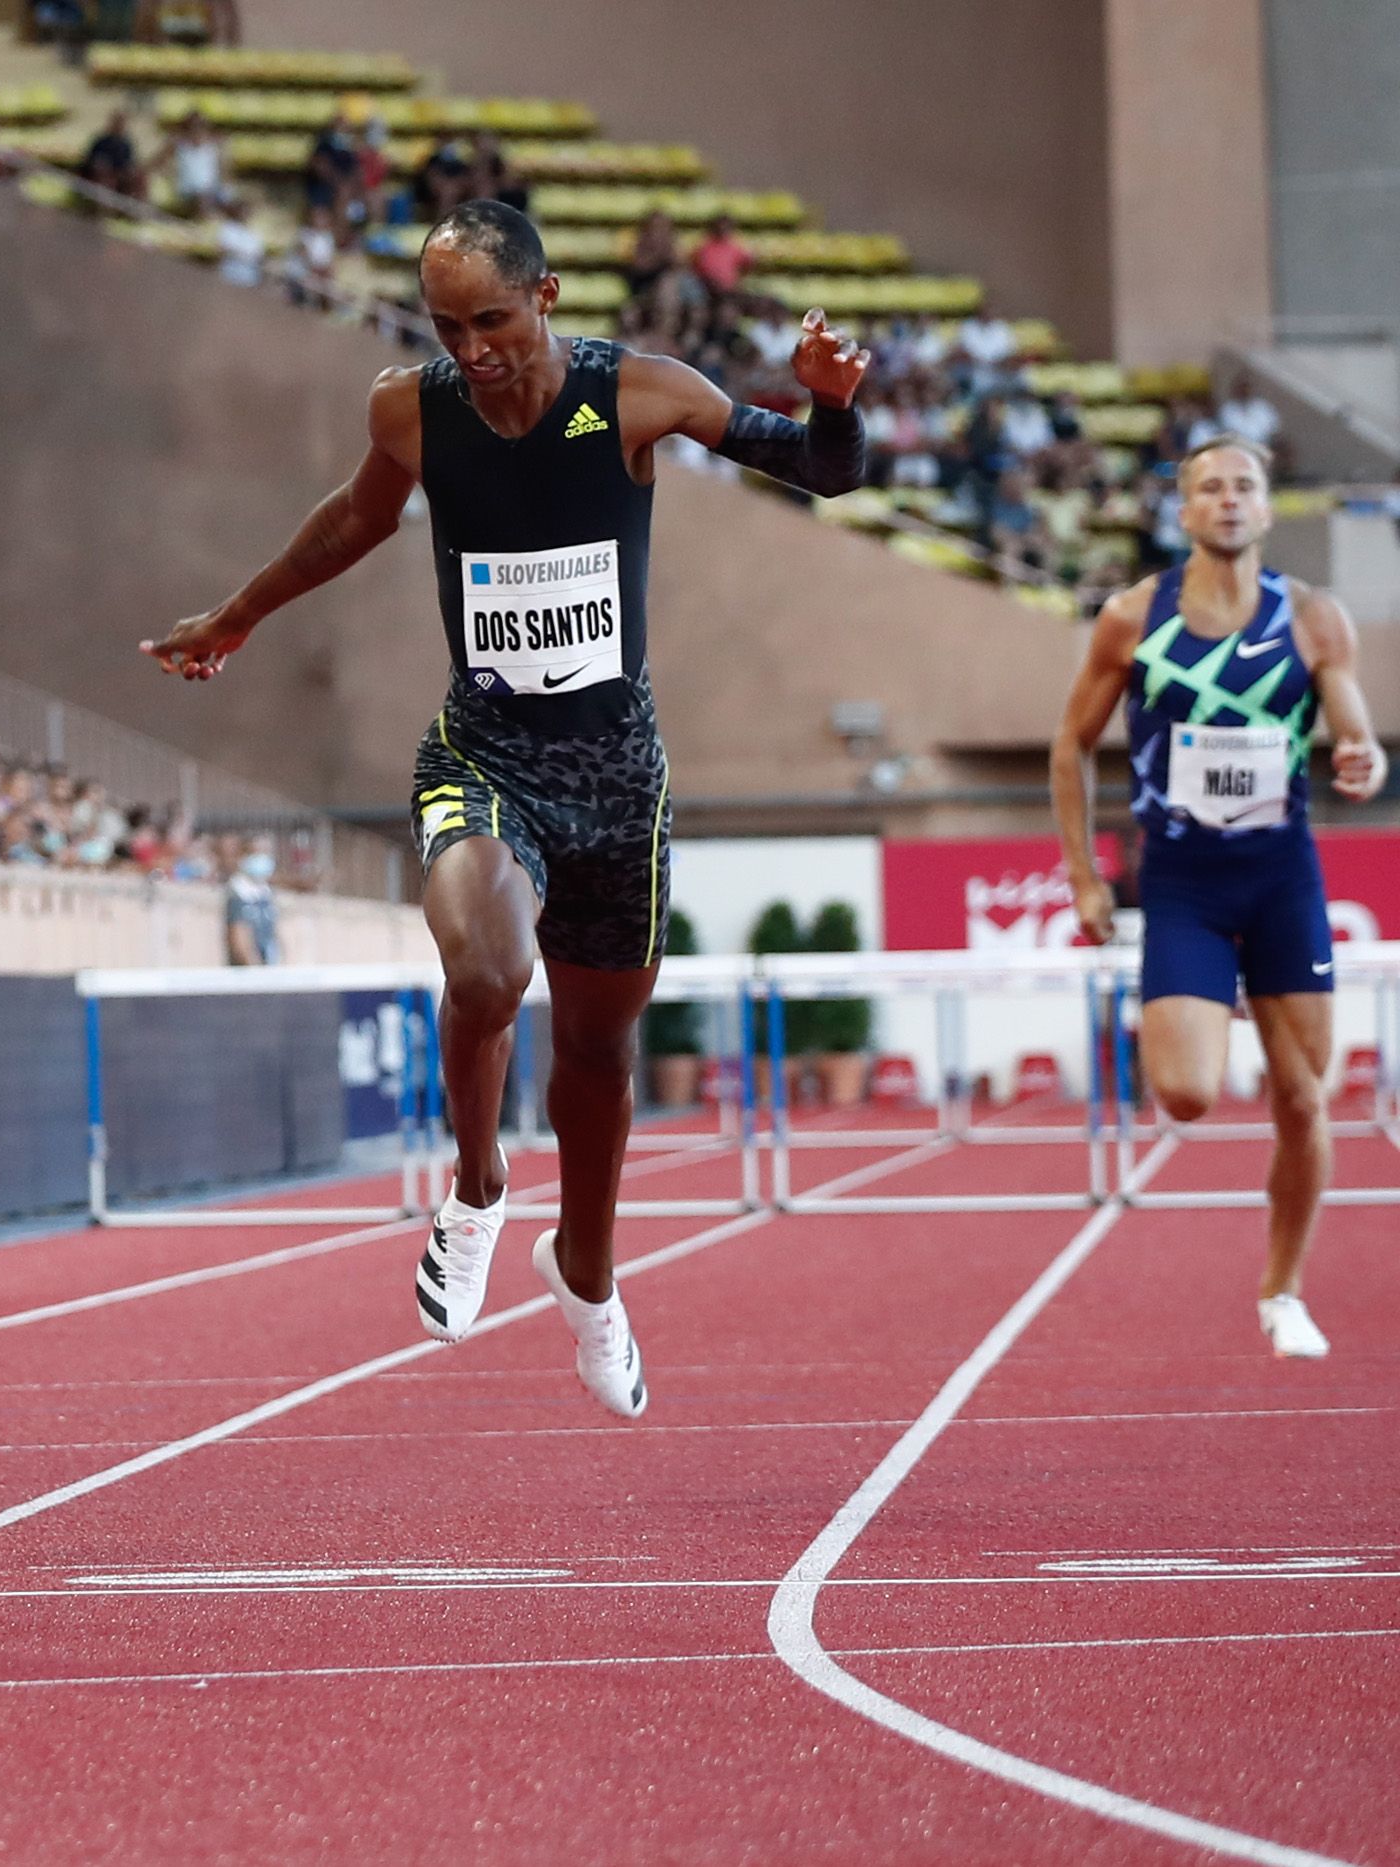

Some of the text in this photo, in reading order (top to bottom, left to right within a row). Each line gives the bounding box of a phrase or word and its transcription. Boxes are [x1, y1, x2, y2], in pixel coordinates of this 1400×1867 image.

[565, 420, 608, 438] adidas
[497, 552, 611, 585] SLOVENIJALES
[474, 597, 614, 652] DOS SANTOS
